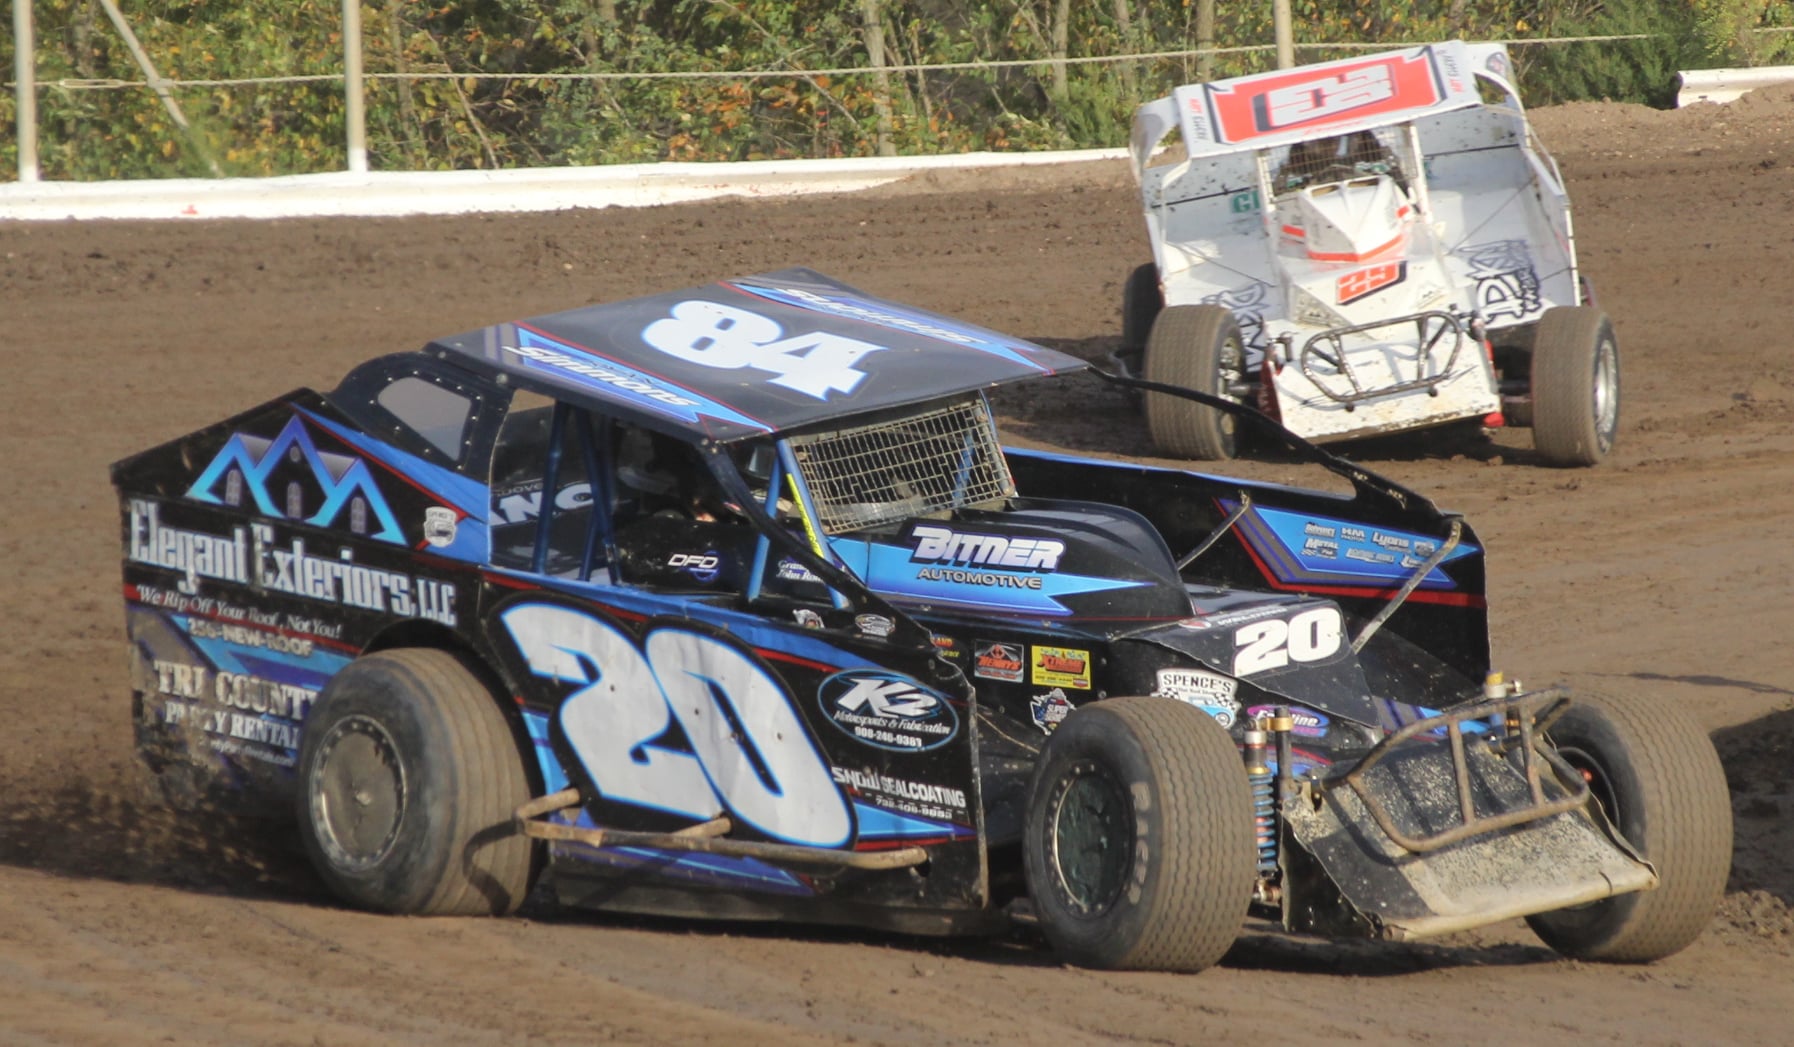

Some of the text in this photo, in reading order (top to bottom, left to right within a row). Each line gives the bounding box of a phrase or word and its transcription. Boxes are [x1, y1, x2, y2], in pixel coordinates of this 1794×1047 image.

[641, 299, 890, 401] 84
[129, 498, 249, 595] Elegant
[417, 577, 457, 627] LLC
[911, 525, 1065, 572] BITNER
[917, 567, 1042, 590] AUTOMOTIVE
[163, 590, 188, 612] Rip
[190, 596, 215, 614] Off
[216, 601, 245, 620] Your
[287, 614, 312, 633] Not
[313, 618, 342, 639] You!
[1233, 606, 1342, 678] 20
[154, 660, 206, 699] TRI
[838, 678, 938, 718] K2
[1163, 673, 1232, 693] SPENCE'S
[500, 602, 853, 849] 20
[899, 718, 951, 735] Fabrication
[880, 776, 967, 808] SEALCOATING
